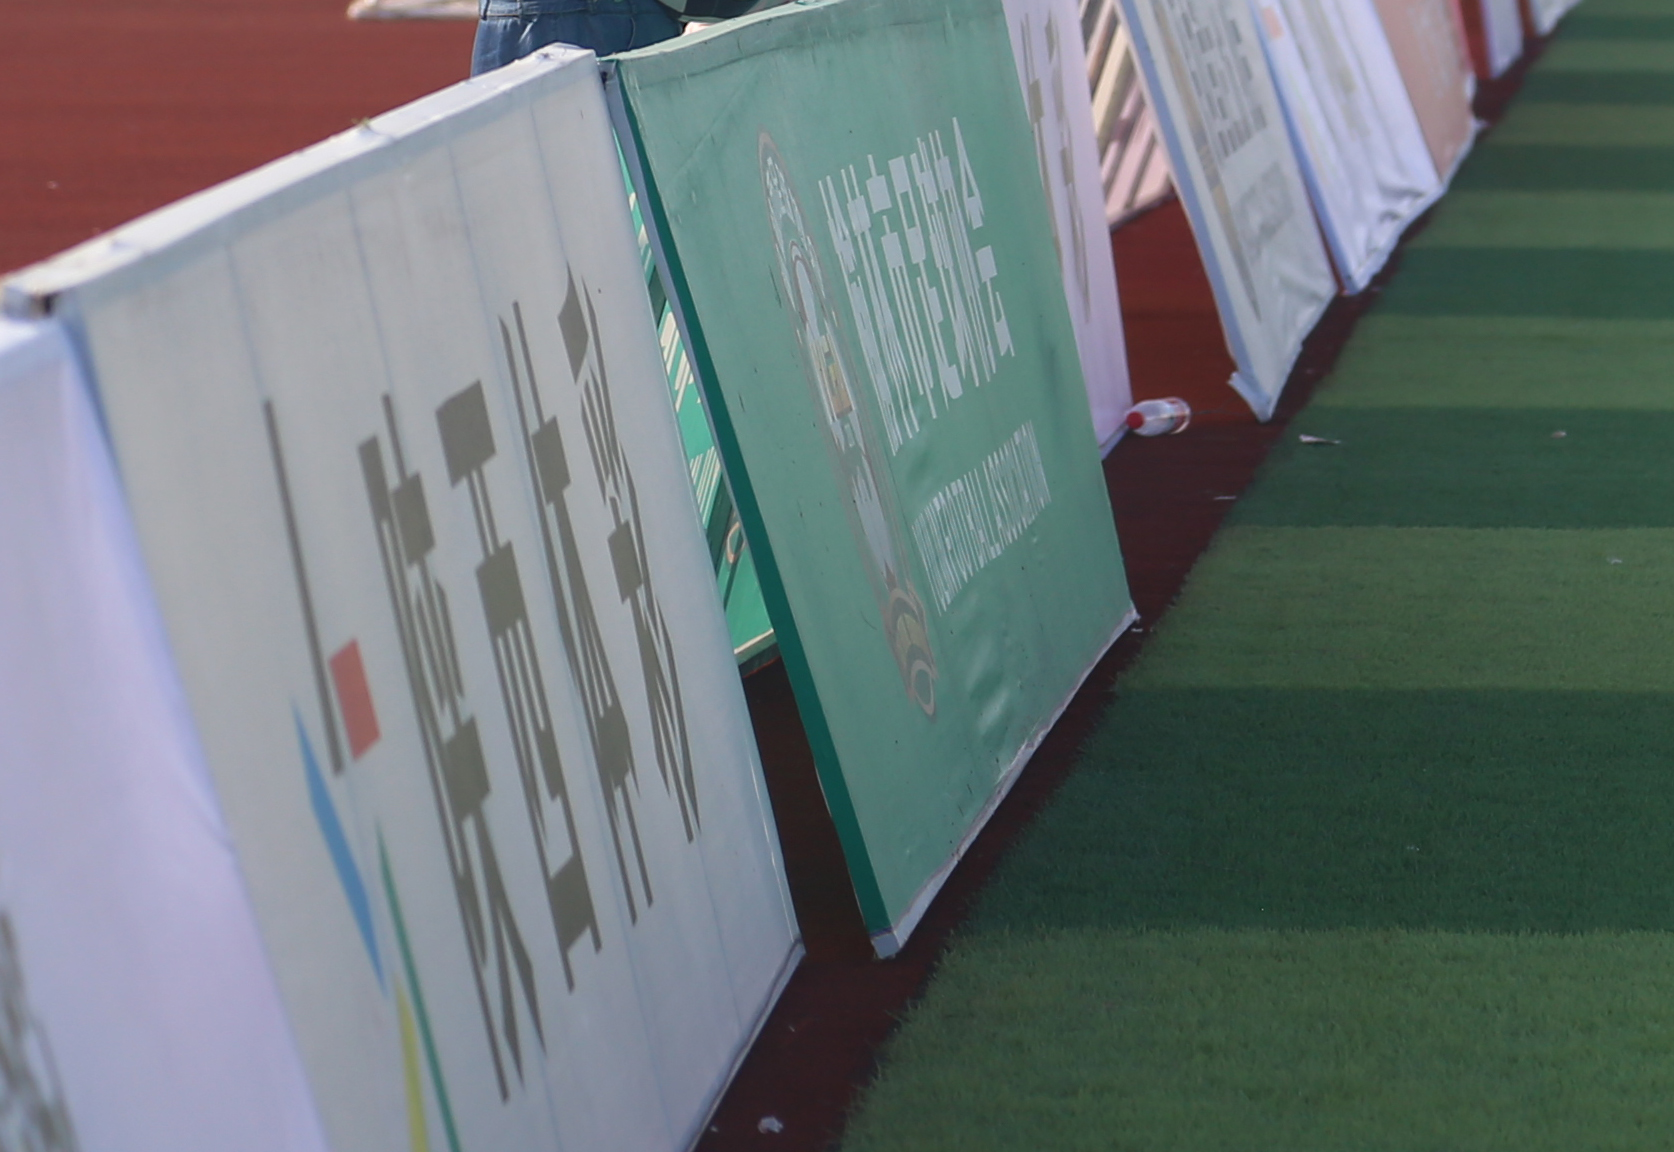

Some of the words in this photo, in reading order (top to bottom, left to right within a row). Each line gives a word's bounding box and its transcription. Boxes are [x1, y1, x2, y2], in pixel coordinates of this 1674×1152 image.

[818, 116, 1015, 457] 榆林市足球协会
[359, 263, 702, 1105] 陕西体彩
